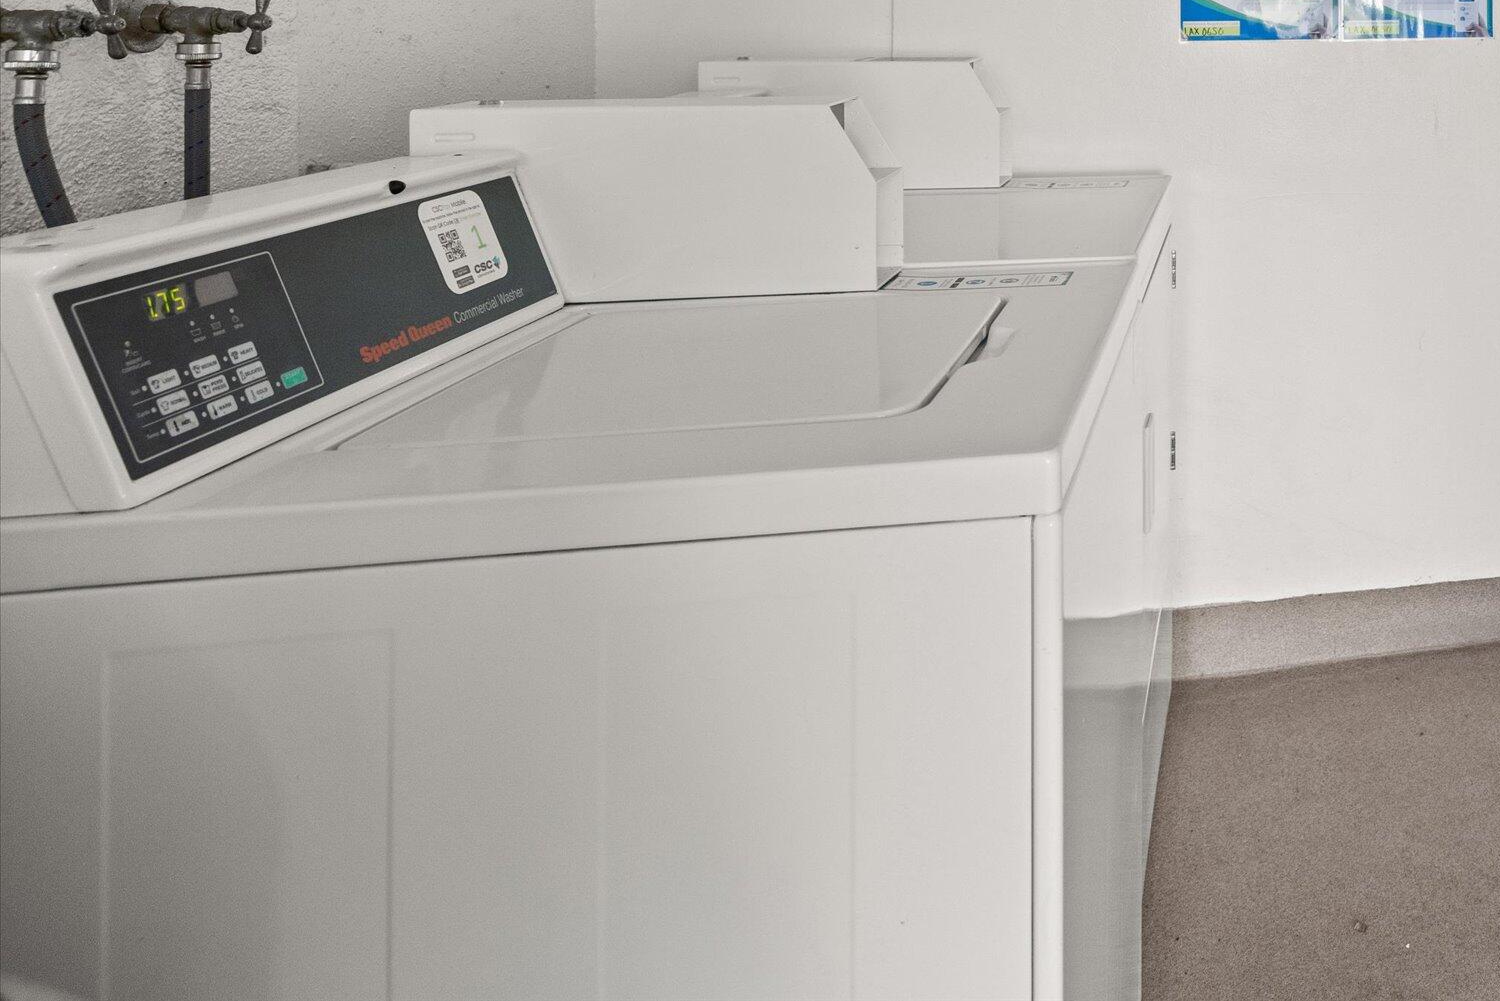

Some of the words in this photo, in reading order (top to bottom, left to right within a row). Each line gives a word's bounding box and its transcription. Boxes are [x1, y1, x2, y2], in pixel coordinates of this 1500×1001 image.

[471, 225, 487, 249] 1
[474, 260, 493, 274] CSC
[359, 330, 410, 364] Speed
[408, 315, 453, 342] Queen
[453, 297, 499, 324] Commercial
[498, 287, 525, 305] Washer
